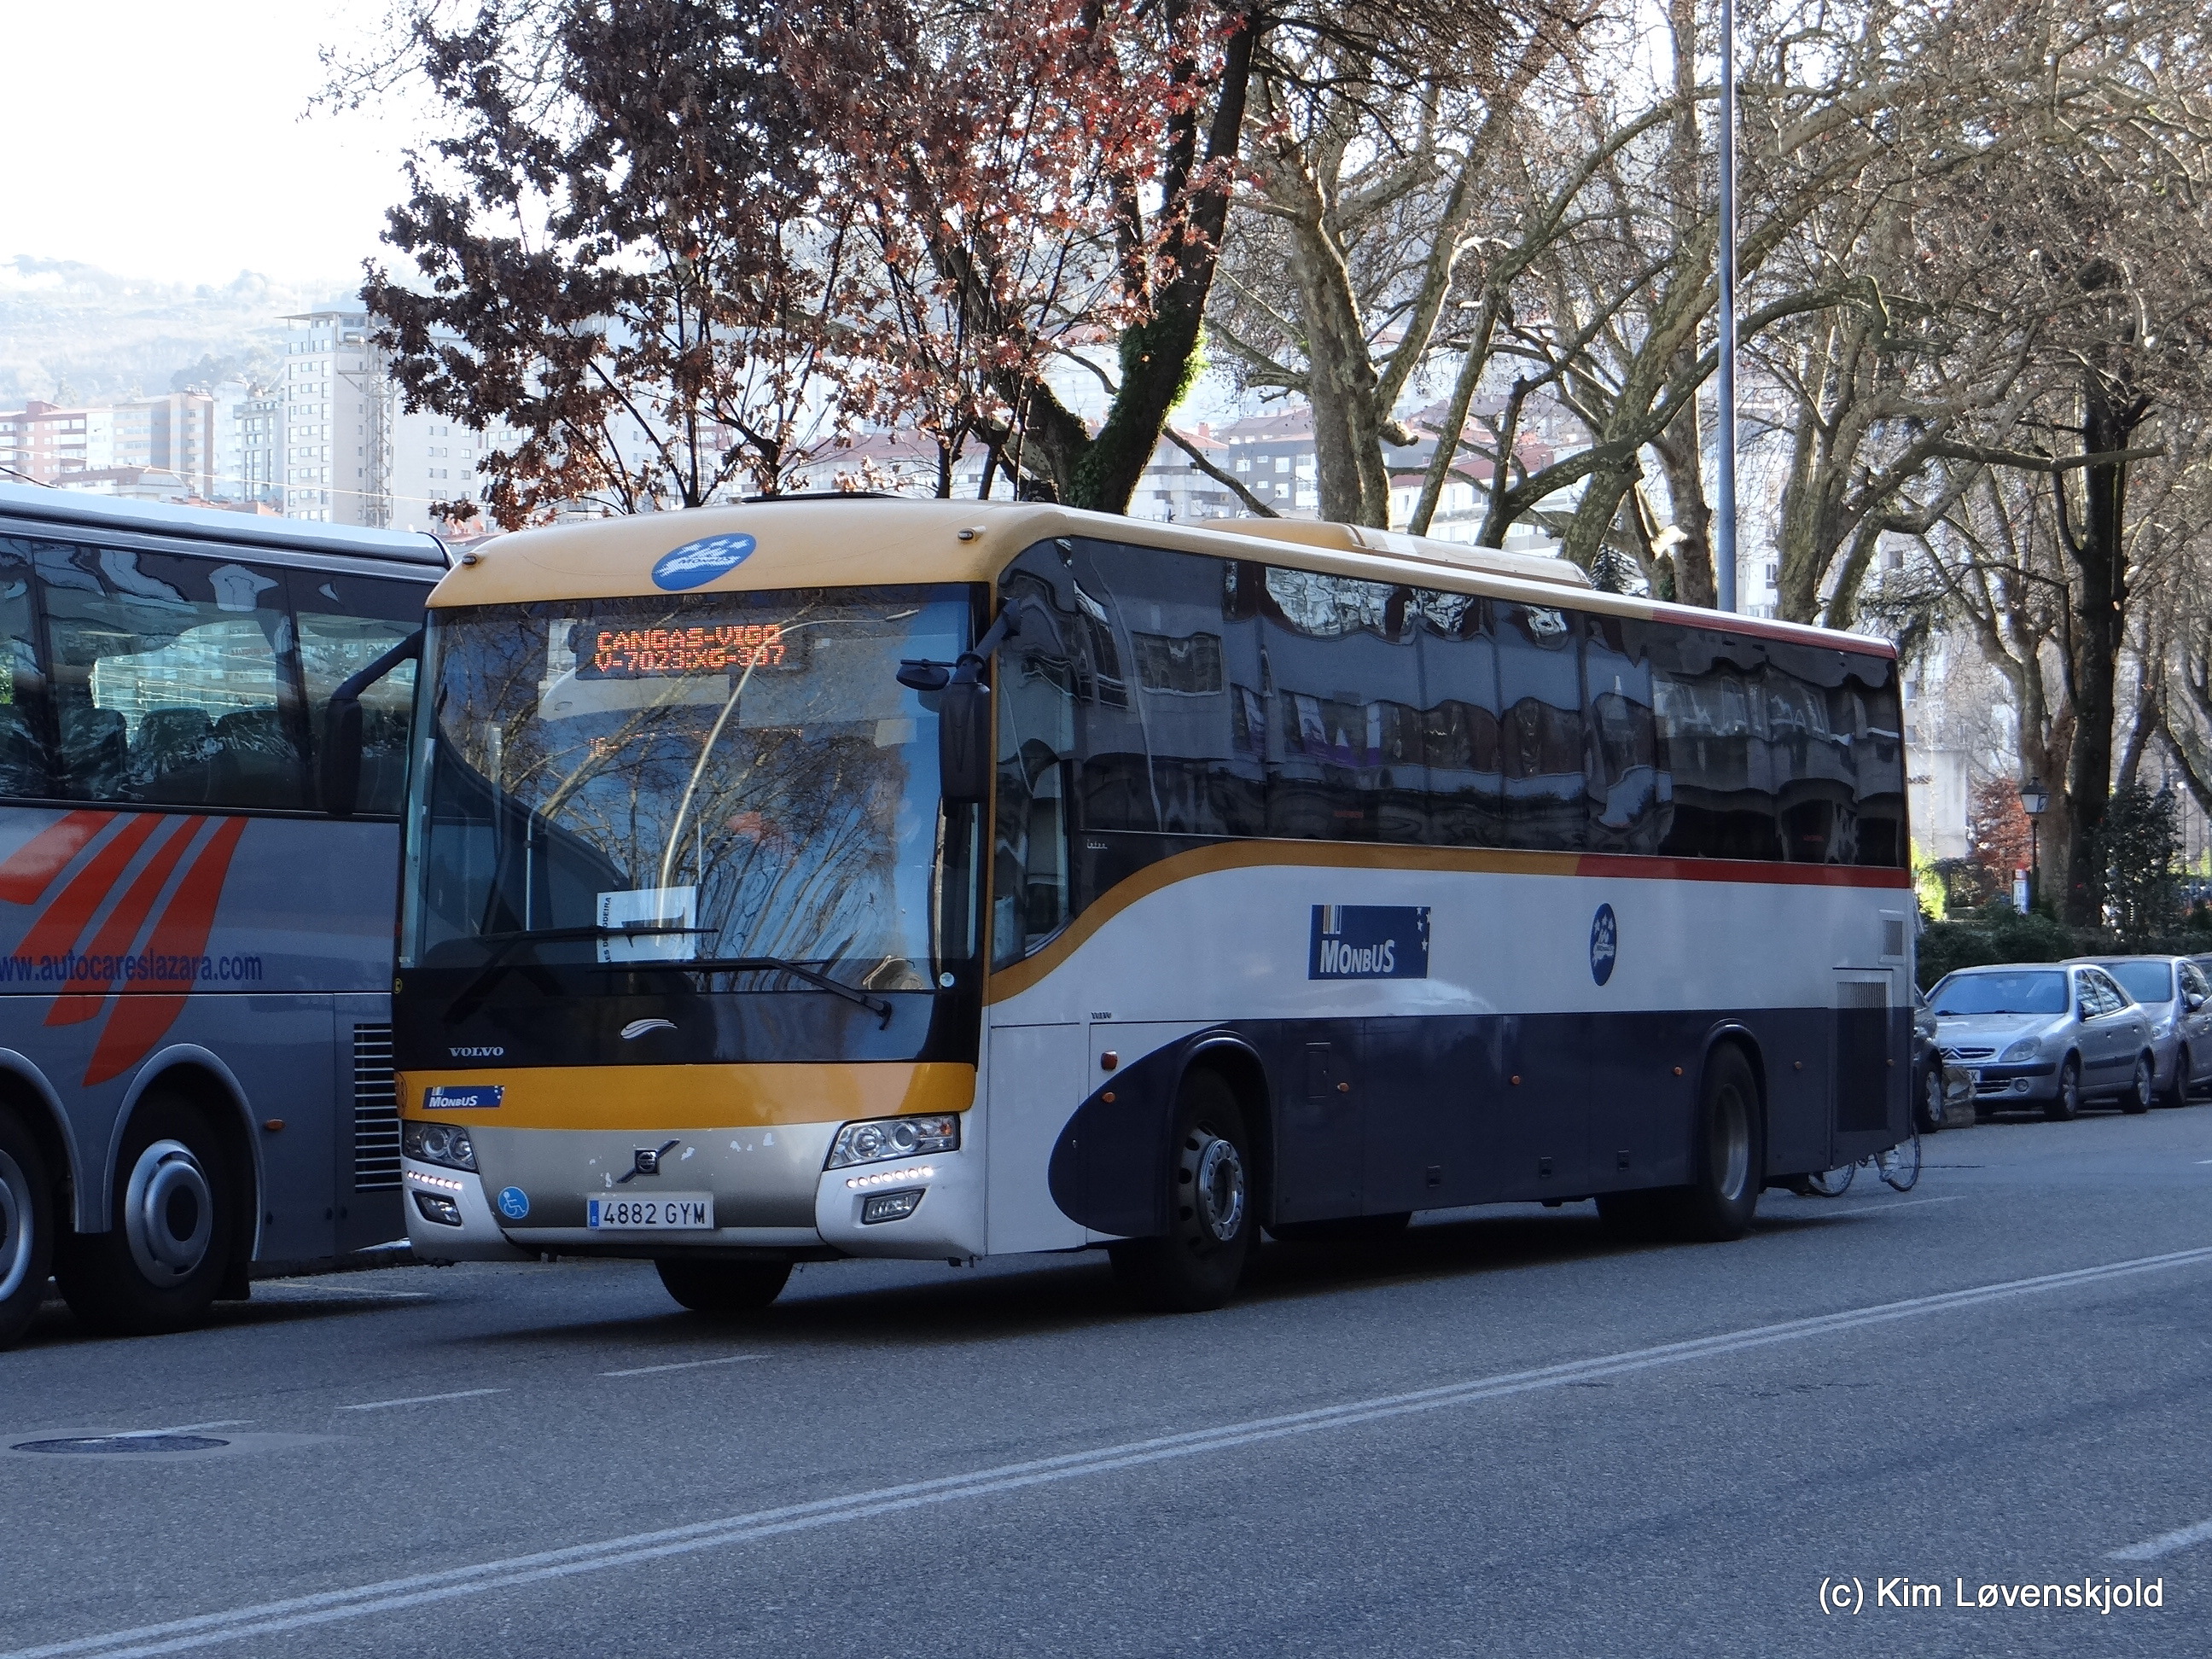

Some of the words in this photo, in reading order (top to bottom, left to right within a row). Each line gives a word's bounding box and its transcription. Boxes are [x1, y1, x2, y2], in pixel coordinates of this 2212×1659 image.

[1319, 939, 1394, 974] MONBUS
[449, 1047, 504, 1057] VOLVO
[428, 1096, 478, 1108] MONBUS
[602, 1203, 656, 1224] 4882
[666, 1202, 705, 1224] GYM
